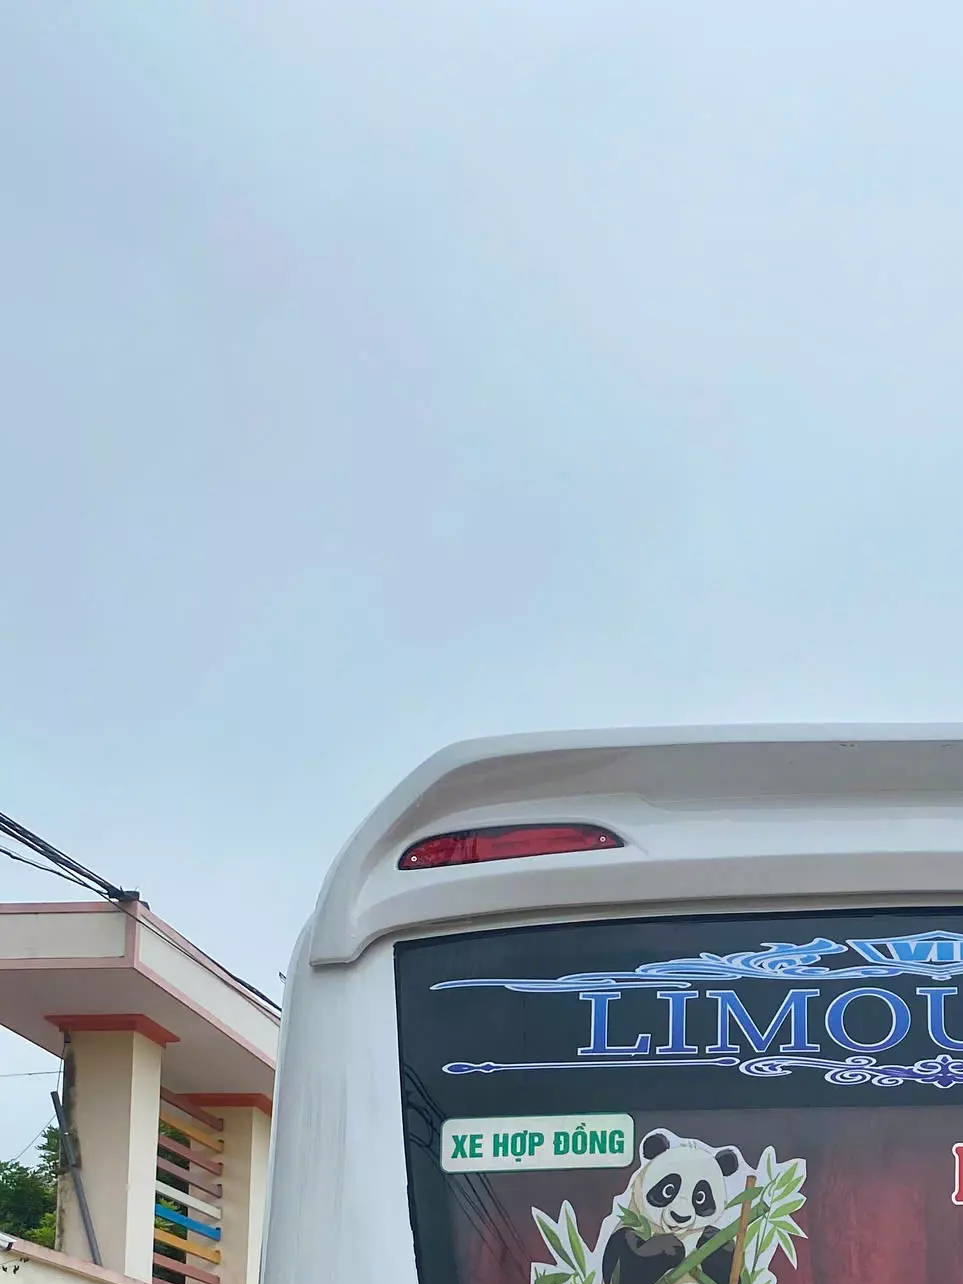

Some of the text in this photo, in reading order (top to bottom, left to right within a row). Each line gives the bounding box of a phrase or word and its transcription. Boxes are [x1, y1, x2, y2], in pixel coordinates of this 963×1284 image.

[450, 1122, 625, 1162] XE HỢP ĐỒNG
